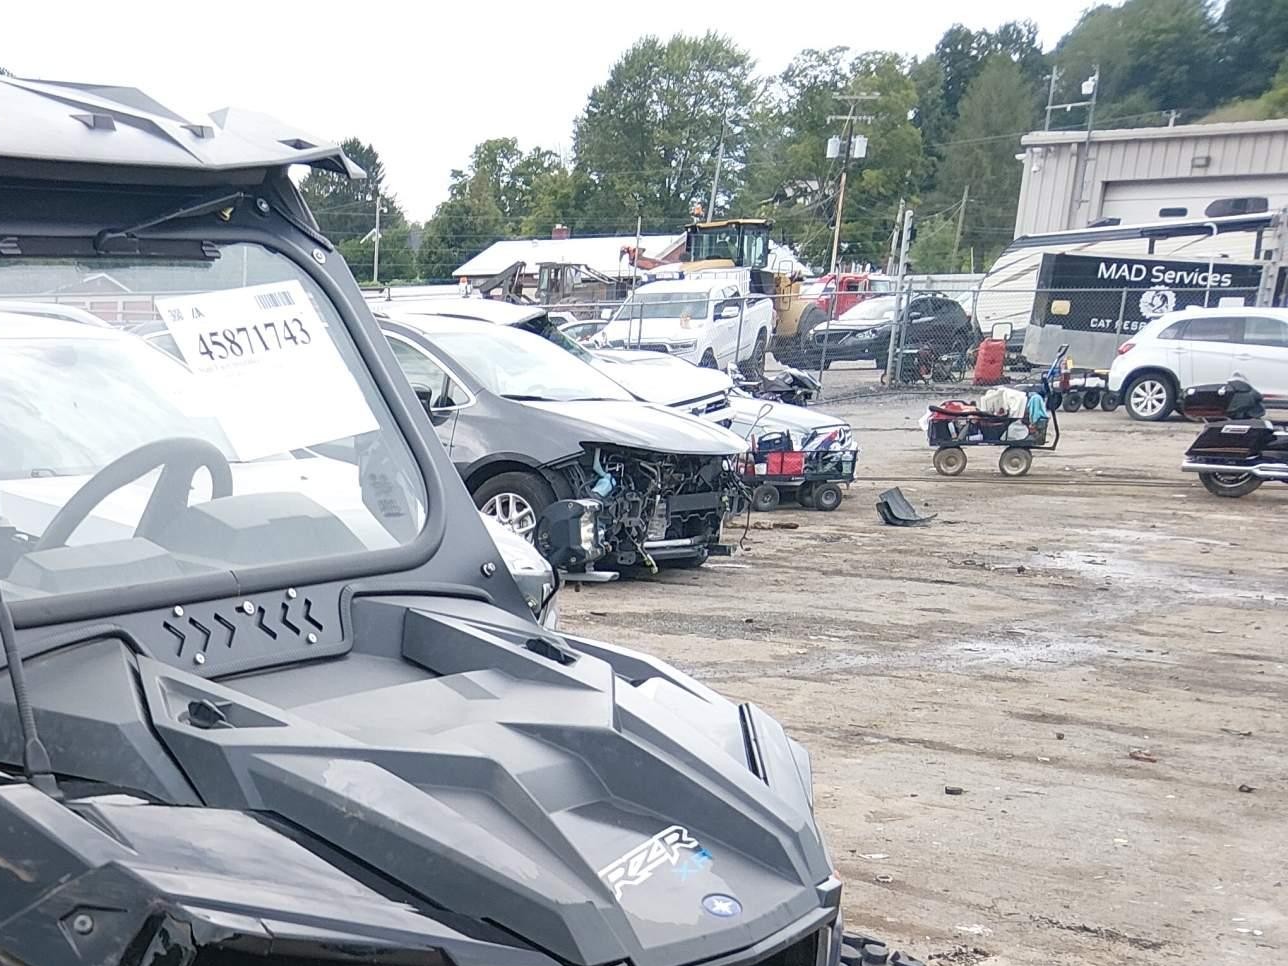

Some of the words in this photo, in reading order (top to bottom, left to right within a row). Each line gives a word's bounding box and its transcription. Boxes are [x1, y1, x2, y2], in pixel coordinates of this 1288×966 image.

[1097, 261, 1147, 281] MAD
[1150, 265, 1232, 287] Services
[198, 317, 312, 361] 45871743
[1090, 318, 1113, 329] CAT
[597, 825, 699, 901] RZR
